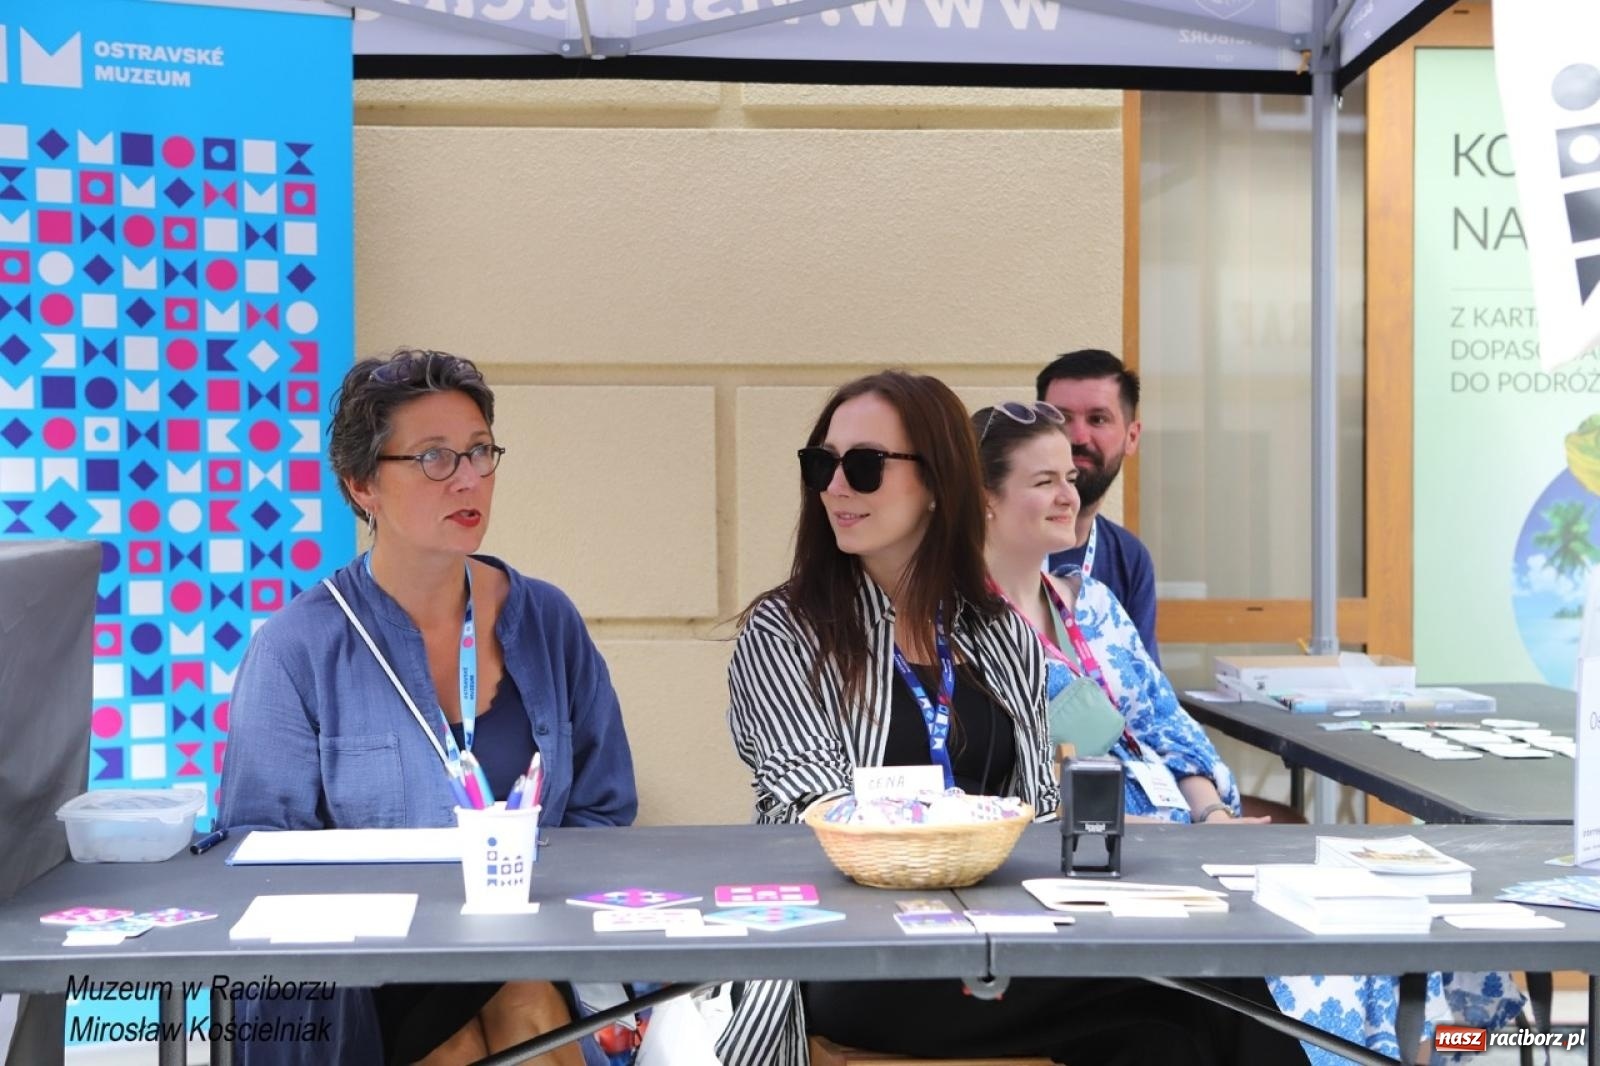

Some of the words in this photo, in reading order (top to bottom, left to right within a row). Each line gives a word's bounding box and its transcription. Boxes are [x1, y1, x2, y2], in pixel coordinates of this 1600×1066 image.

[94, 40, 225, 67] OSTRAVSKÉ
[94, 65, 191, 88] MUZEUM
[1450, 307, 1465, 329] Z
[1474, 307, 1539, 329] KART
[1451, 371, 1490, 393] DO
